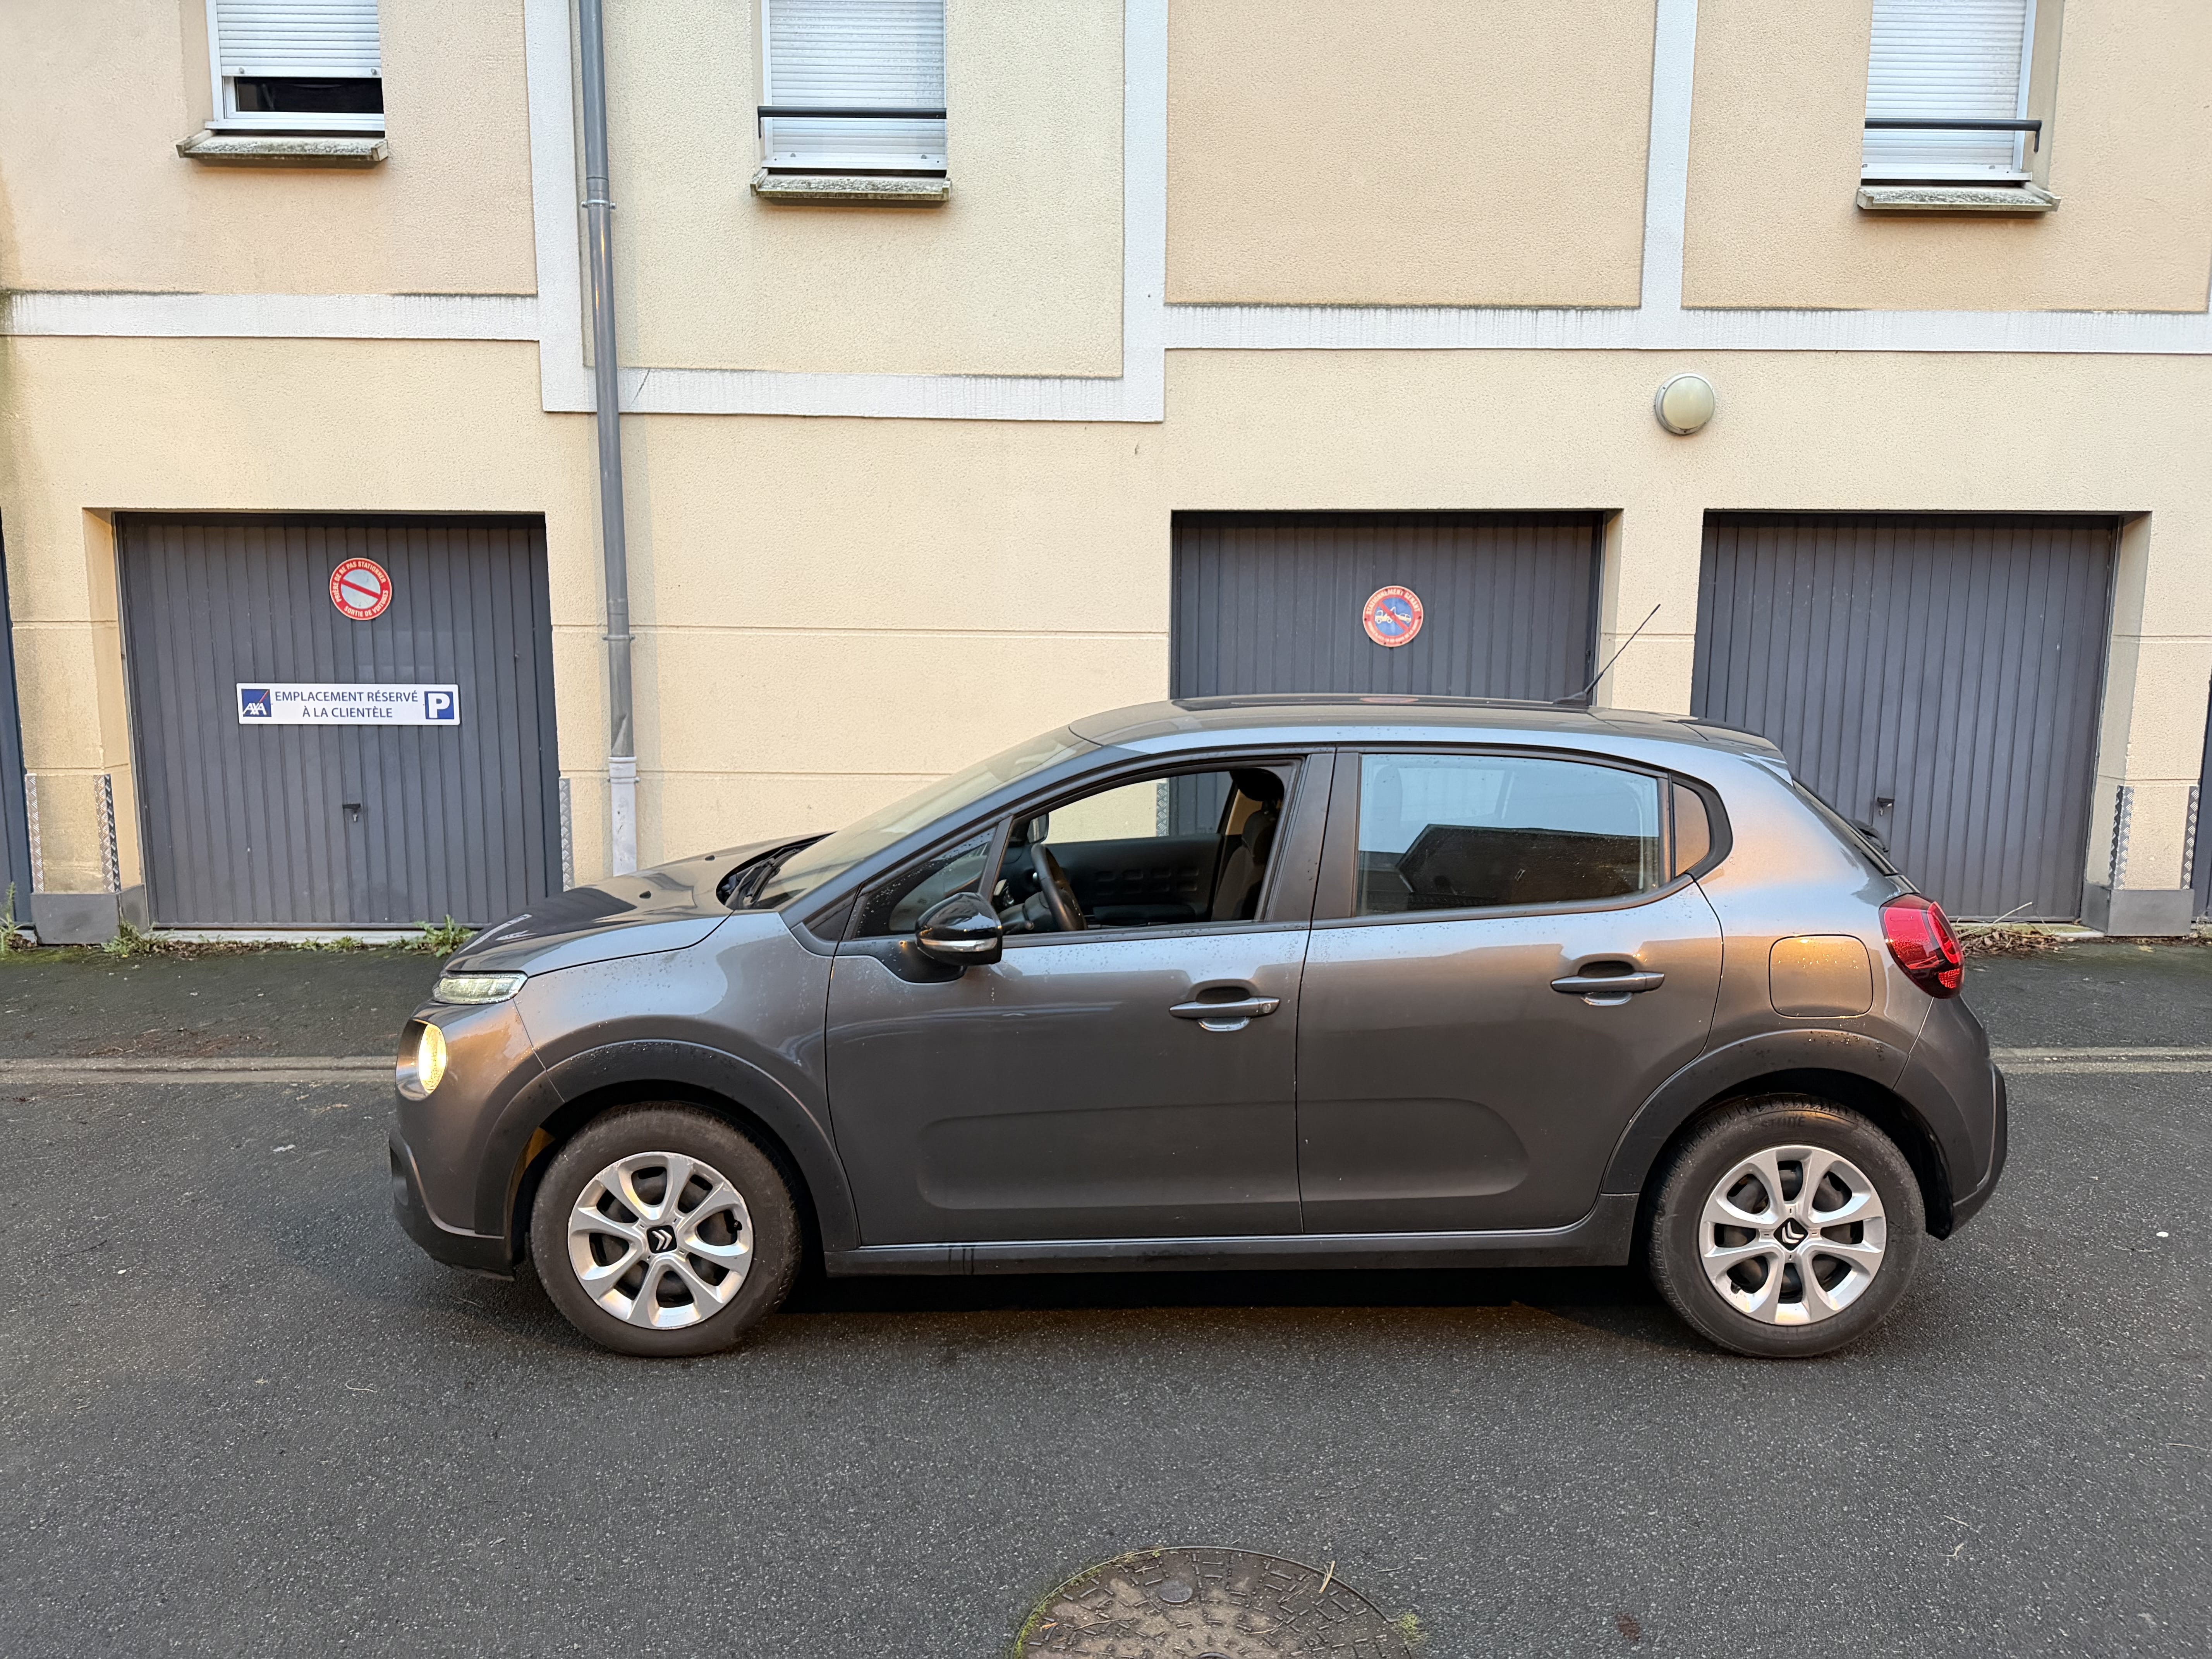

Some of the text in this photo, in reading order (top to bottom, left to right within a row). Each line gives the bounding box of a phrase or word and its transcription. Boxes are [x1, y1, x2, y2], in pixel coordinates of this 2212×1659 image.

[332, 561, 386, 602] PRIÈRE DE NE PAS STATIONNER
[344, 606, 363, 617] SORTIE
[275, 690, 418, 702] EMPLACEMENT RÉSERVÉ
[243, 702, 267, 715] AXA
[428, 693, 450, 718] P
[302, 706, 393, 718] À LA CLIENTÈLE
